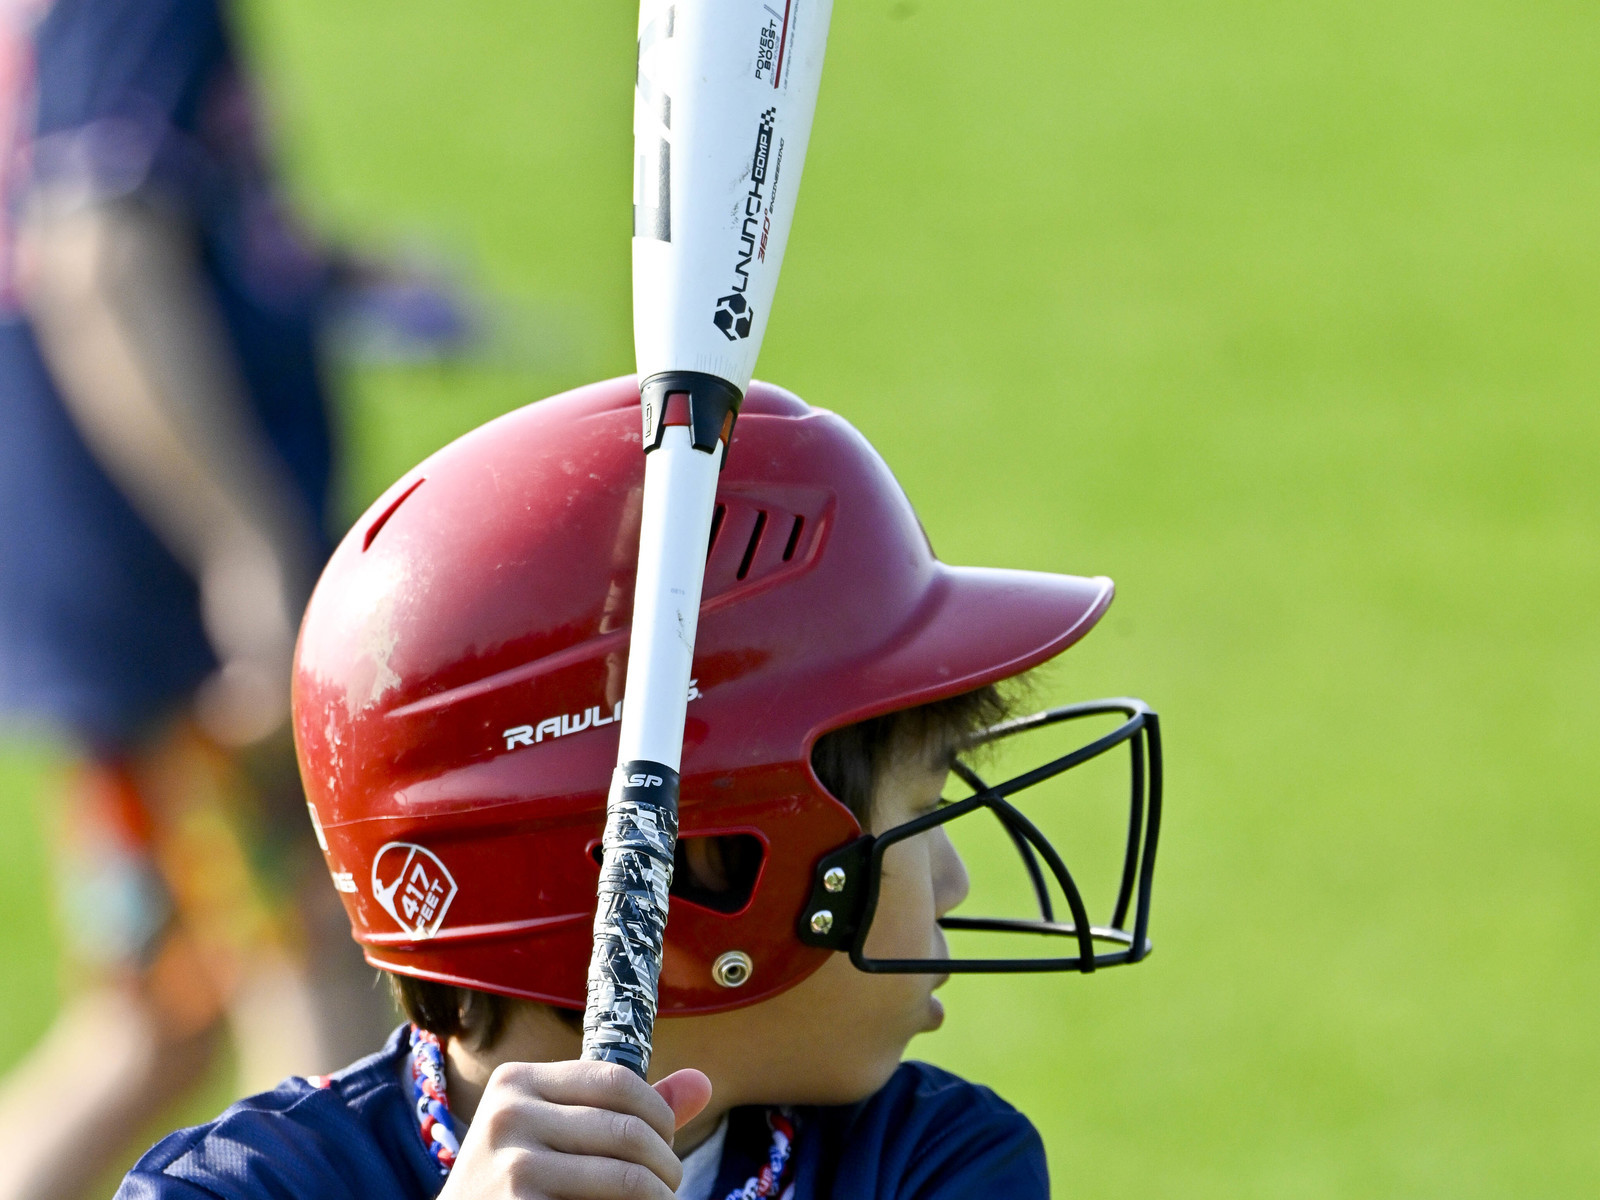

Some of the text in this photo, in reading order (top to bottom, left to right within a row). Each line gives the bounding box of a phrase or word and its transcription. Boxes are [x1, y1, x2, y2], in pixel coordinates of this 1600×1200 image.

[755, 26, 769, 80] POWER
[764, 19, 777, 71] BOOST
[754, 133, 768, 180] COMP
[769, 137, 785, 215] ENGINEERING
[401, 862, 430, 920] 417
[416, 877, 444, 927] FEET
